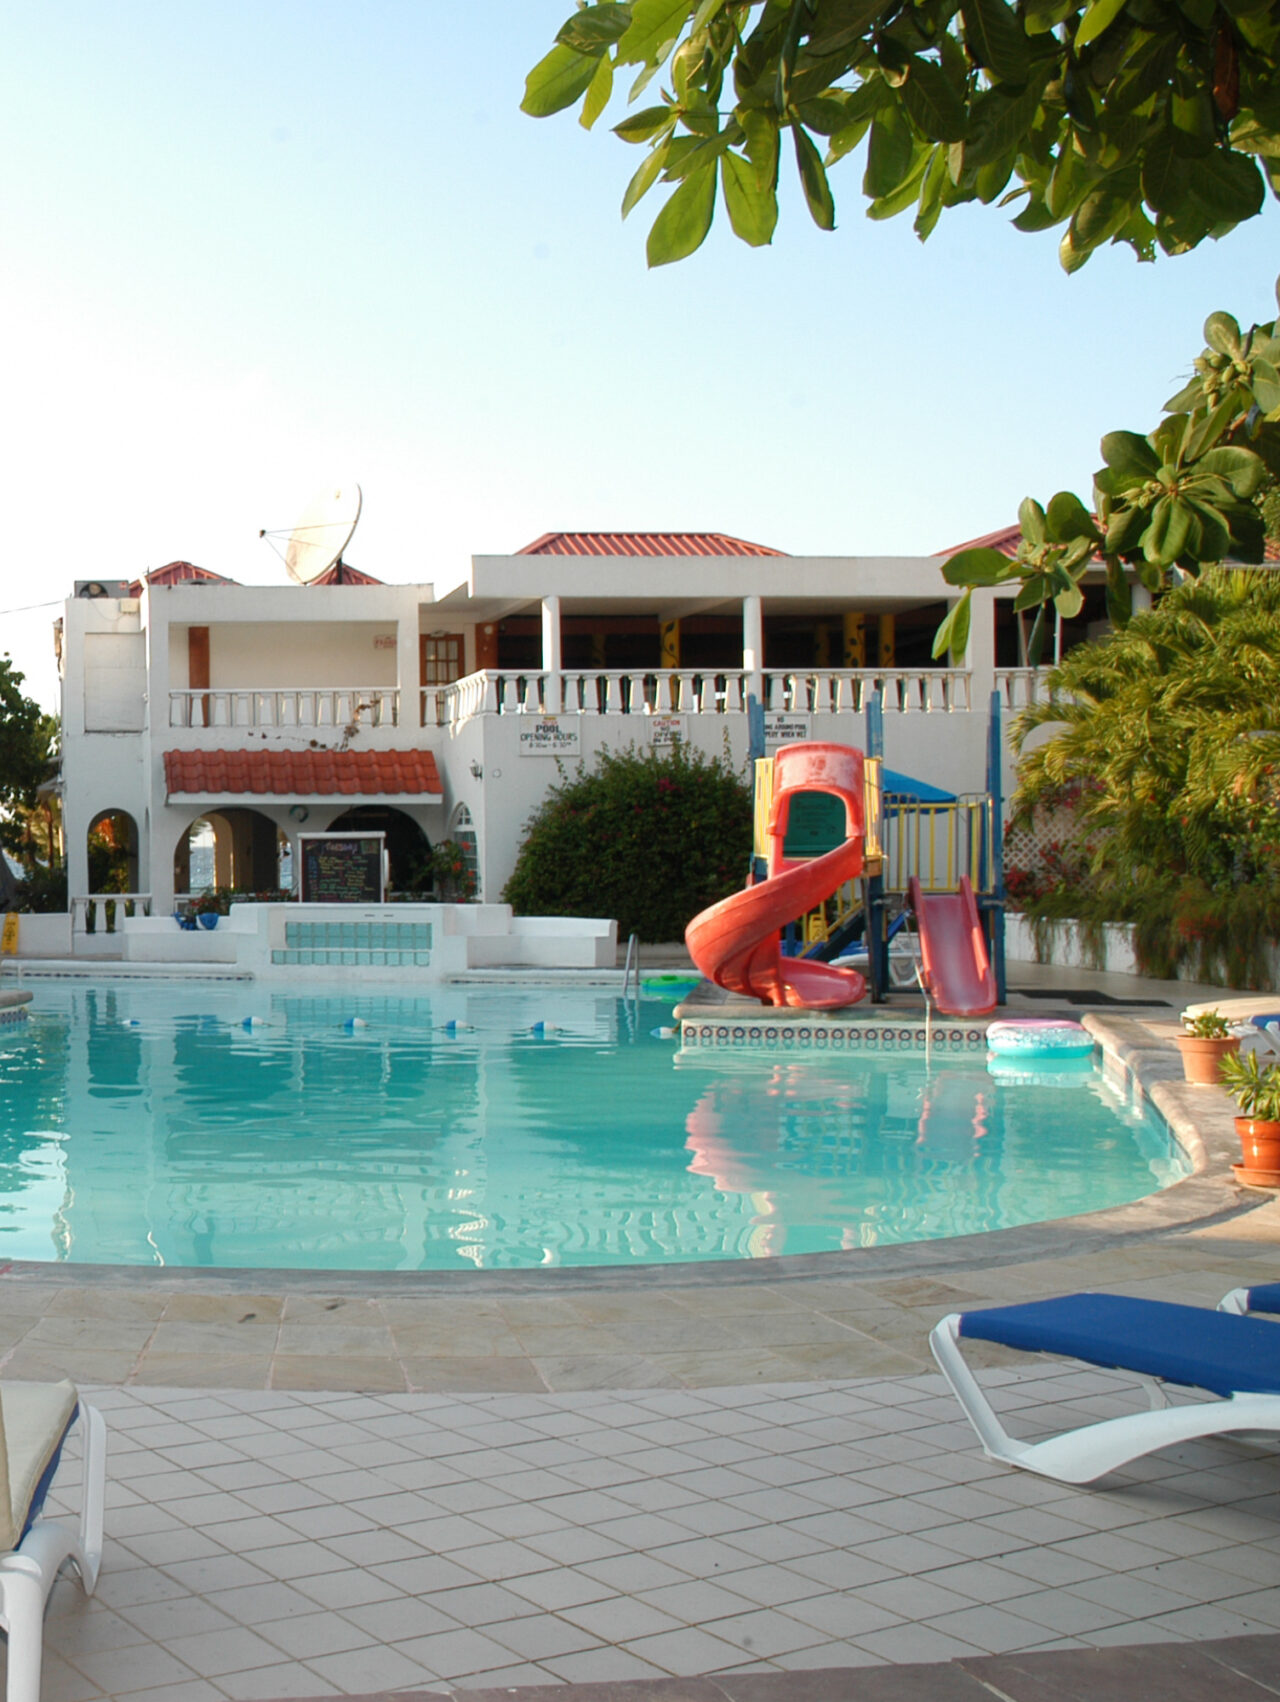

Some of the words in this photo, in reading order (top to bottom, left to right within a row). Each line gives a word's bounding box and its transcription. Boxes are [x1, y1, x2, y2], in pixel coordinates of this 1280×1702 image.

[535, 724, 560, 733] POOL
[520, 733, 552, 742] OPENING
[553, 733, 578, 742] HOURS
